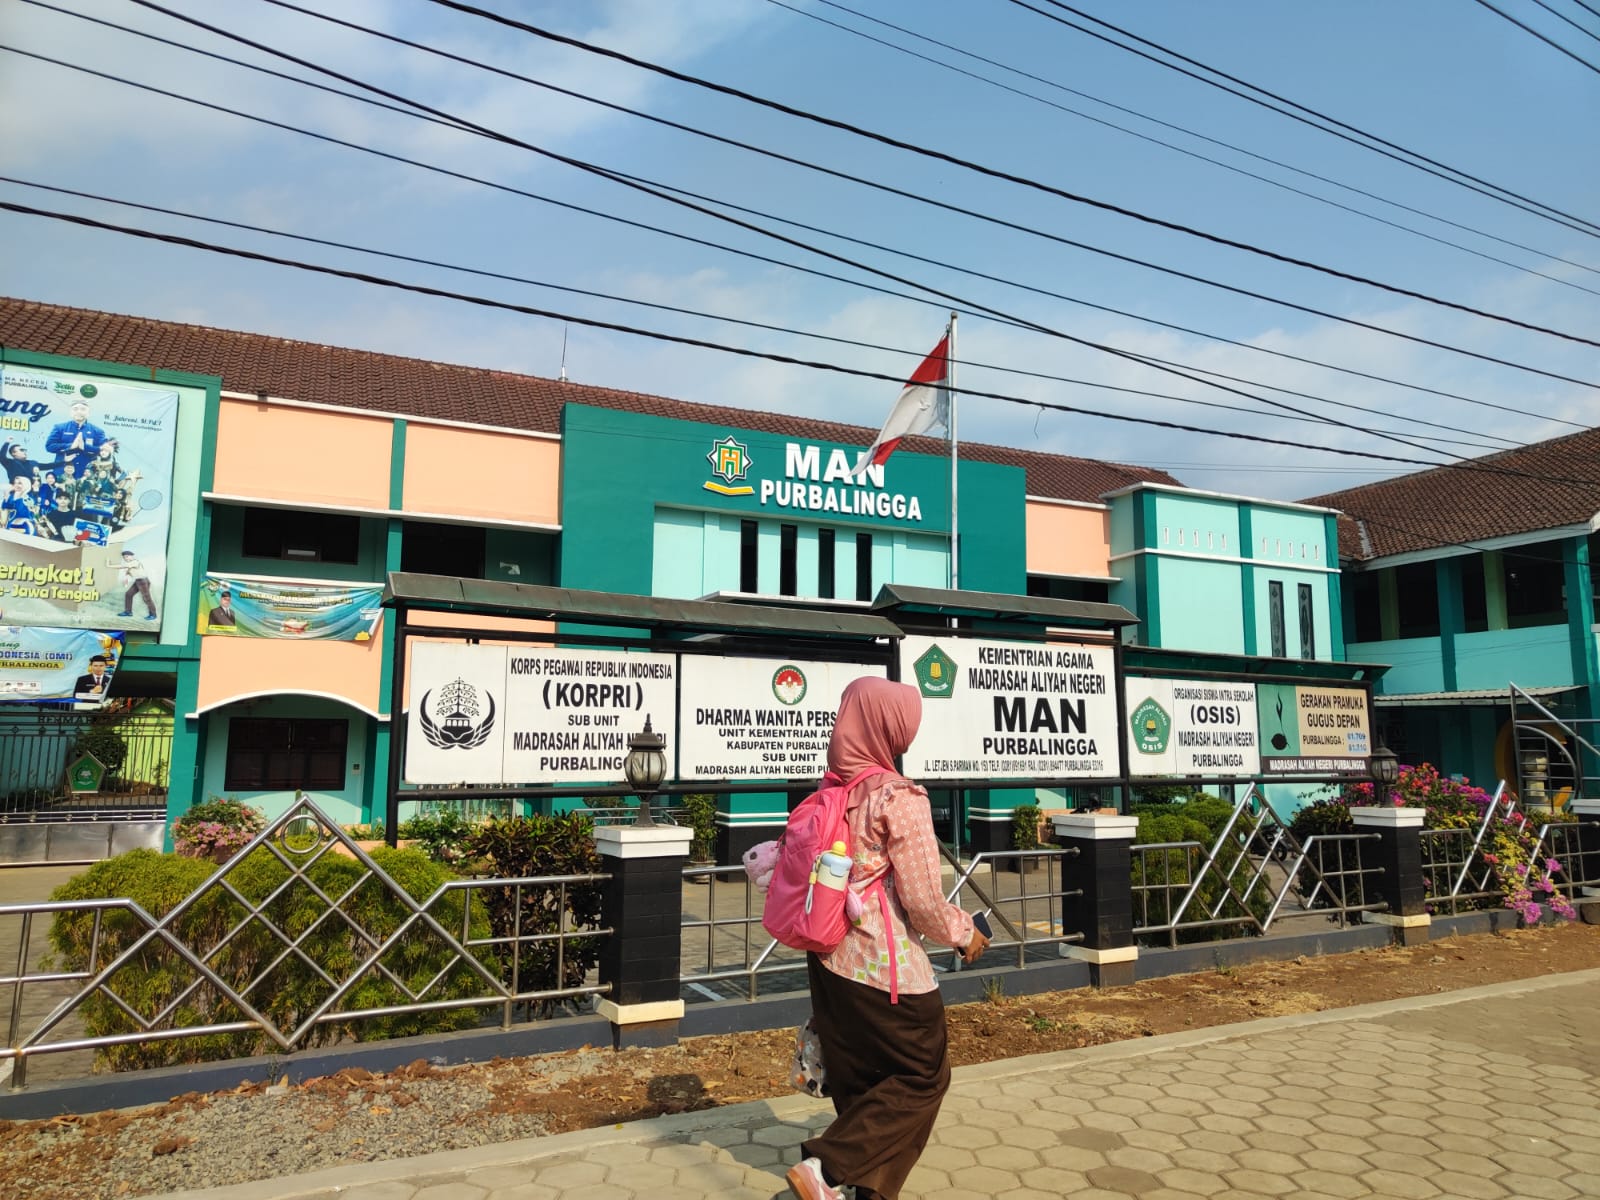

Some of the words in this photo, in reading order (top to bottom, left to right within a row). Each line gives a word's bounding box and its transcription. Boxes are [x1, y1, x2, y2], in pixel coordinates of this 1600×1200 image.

[785, 442, 885, 488] MAN
[760, 479, 922, 521] PURBALINGGA
[84, 566, 94, 586] 1
[12, 584, 50, 599] Jawa
[51, 586, 100, 602] Tengah
[978, 646, 1052, 668] KEMENTRIAN
[1056, 651, 1094, 670] AGAMA
[511, 658, 541, 675] KORPS
[544, 659, 583, 677] PEGAWAI
[586, 661, 627, 678] REPUBLIK
[629, 663, 672, 680] INDONESIA
[968, 668, 1028, 692] MADRASAH
[1031, 671, 1067, 693] ALIYAH
[1070, 673, 1106, 694] NEGERI
[1174, 688, 1202, 700] ORGANISASI
[1204, 689, 1218, 700] SISWA
[1220, 690, 1232, 700] INTRA
[1234, 690, 1254, 702] SEKOLAH
[1300, 694, 1332, 709] GERAKAN
[1333, 695, 1364, 710] PRAMUKA
[568, 714, 590, 726] SUB
[594, 715, 620, 727] UNIT
[696, 708, 752, 726] DHARMA
[756, 709, 804, 727] WANITA
[993, 696, 1087, 734] MAN
[1191, 704, 1240, 726] (OSIS)
[1307, 713, 1334, 728] GUGUS
[1336, 714, 1360, 728] DEPAN
[718, 728, 746, 738] UNIT
[749, 729, 818, 738] KEMENTRIAN
[1178, 731, 1210, 746] MADRASAH
[1213, 732, 1232, 746] ALIYAH
[1234, 732, 1254, 746] NEGERI
[1302, 735, 1342, 745] PURBALINGGA
[513, 732, 579, 750] MADRASAH
[582, 732, 624, 750] ALIYAH
[726, 741, 783, 750] KABUPATEN
[983, 737, 1098, 756] PURBALINGGA
[1142, 742, 1163, 751] OSIS
[540, 756, 628, 771] PURBALING
[762, 753, 786, 762] SUB
[790, 753, 818, 762] UNIT
[1192, 754, 1243, 767] PURBALINGGA
[1270, 760, 1298, 770] MADRASAH
[1298, 760, 1315, 770] ALIYAH
[1316, 760, 1334, 770] NEGERI
[1334, 760, 1366, 770] PURBALINGGA
[695, 765, 747, 775] MADRASAH
[750, 766, 781, 775] ALIYAH
[784, 766, 816, 775] NEGERI
[1064, 760, 1092, 772] PURBALINGGA
